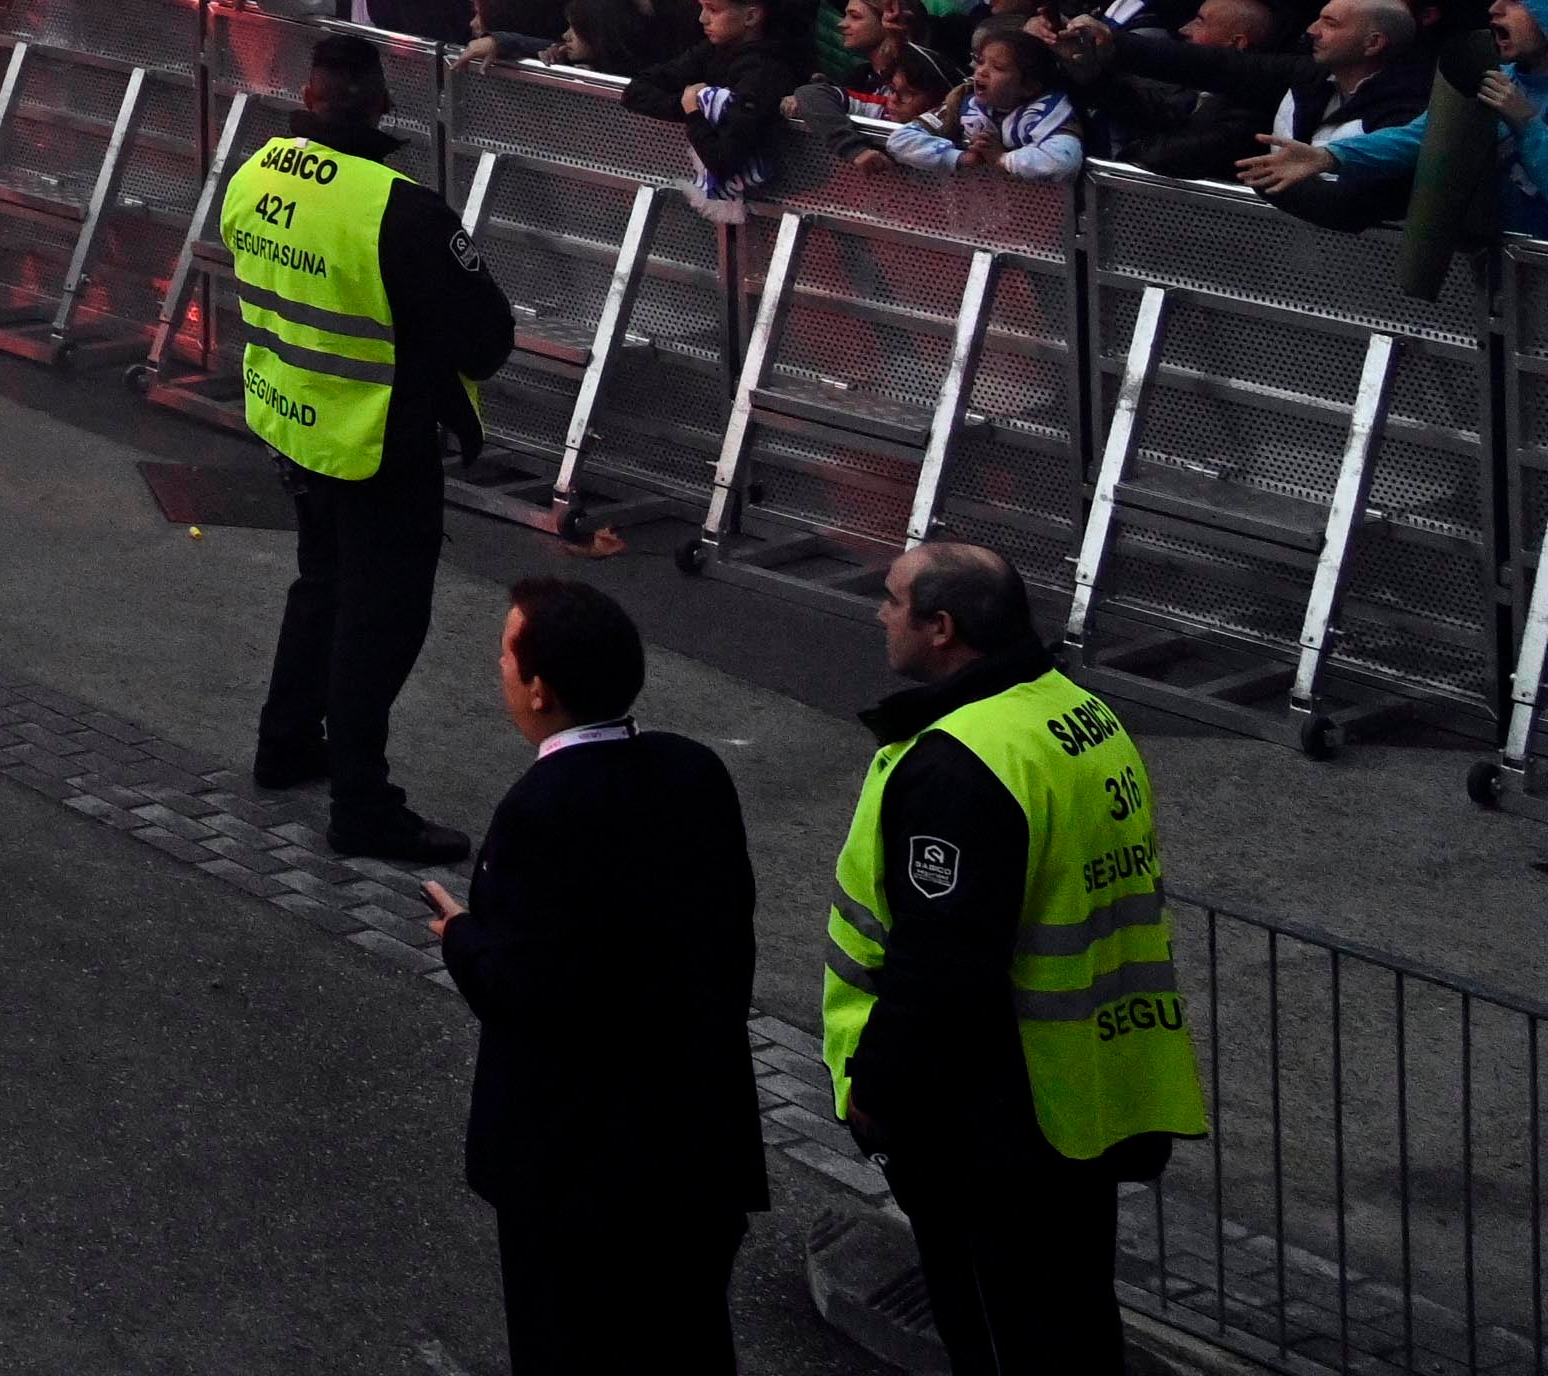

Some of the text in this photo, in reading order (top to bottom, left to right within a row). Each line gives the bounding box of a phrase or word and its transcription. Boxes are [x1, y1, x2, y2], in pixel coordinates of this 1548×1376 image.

[260, 146, 338, 186] SABICO
[255, 192, 297, 230] 421
[1105, 765, 1142, 822] 316
